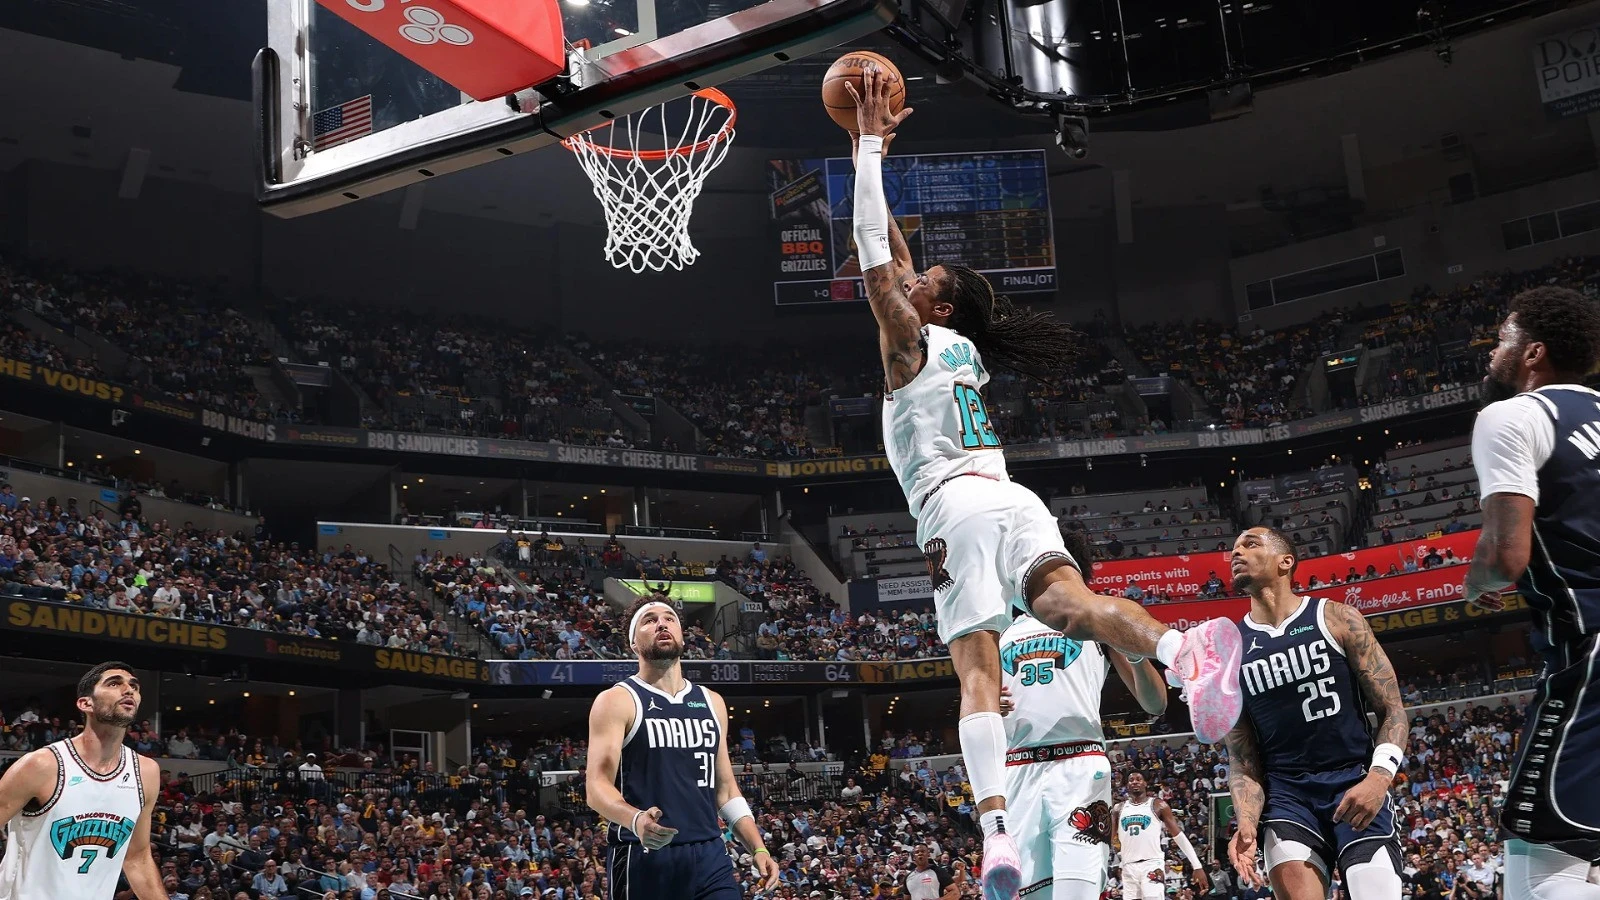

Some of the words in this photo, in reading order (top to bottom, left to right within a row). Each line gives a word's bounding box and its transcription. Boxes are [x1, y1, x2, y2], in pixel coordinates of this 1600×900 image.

[781, 229, 823, 242] OFFICIAL
[782, 241, 825, 255] BBQ
[781, 259, 827, 272] GRIZZLIES
[1003, 274, 1054, 286] FINAL/OT
[814, 289, 829, 298] 1-0
[36, 367, 124, 402] 'VOUS?
[954, 381, 1003, 450] 12
[1360, 400, 1410, 423] SAUSAGE
[1422, 389, 1466, 410] CHEESE
[202, 408, 225, 431] BBQ
[228, 415, 276, 441] NACHOS
[368, 432, 394, 449] BBQ
[398, 433, 479, 455] SANDWICHES
[1197, 432, 1220, 447] BBQ
[1222, 425, 1291, 445] SANDWICHES
[1058, 442, 1080, 457] BBQ
[1083, 439, 1126, 456] NACHOS
[558, 446, 608, 465] SAUSAGE
[622, 451, 663, 469] CHEESE
[666, 455, 697, 471] PLATE
[766, 458, 866, 478] ENJOYING
[1126, 568, 1162, 583] points
[1164, 567, 1190, 579] with
[1176, 583, 1200, 596] App
[745, 603, 762, 611] 112A
[1444, 607, 1459, 620] &
[8, 602, 228, 650] SANDWICHES
[1290, 624, 1314, 636] chime
[374, 650, 477, 679] SAUSAGE
[551, 664, 574, 683] 41
[711, 664, 740, 681] 3:08
[754, 664, 797, 672] TIMEOUTS:
[825, 664, 850, 681] 64
[1021, 661, 1053, 687] 35
[1242, 640, 1331, 696] MAVS
[687, 701, 706, 709] chime
[1297, 676, 1341, 722] 25
[645, 718, 716, 748] MAVS
[694, 752, 715, 788] 31
[75, 812, 121, 822] VANCOUVER
[50, 816, 136, 861] GRIZZLIES
[77, 849, 98, 874] 7
